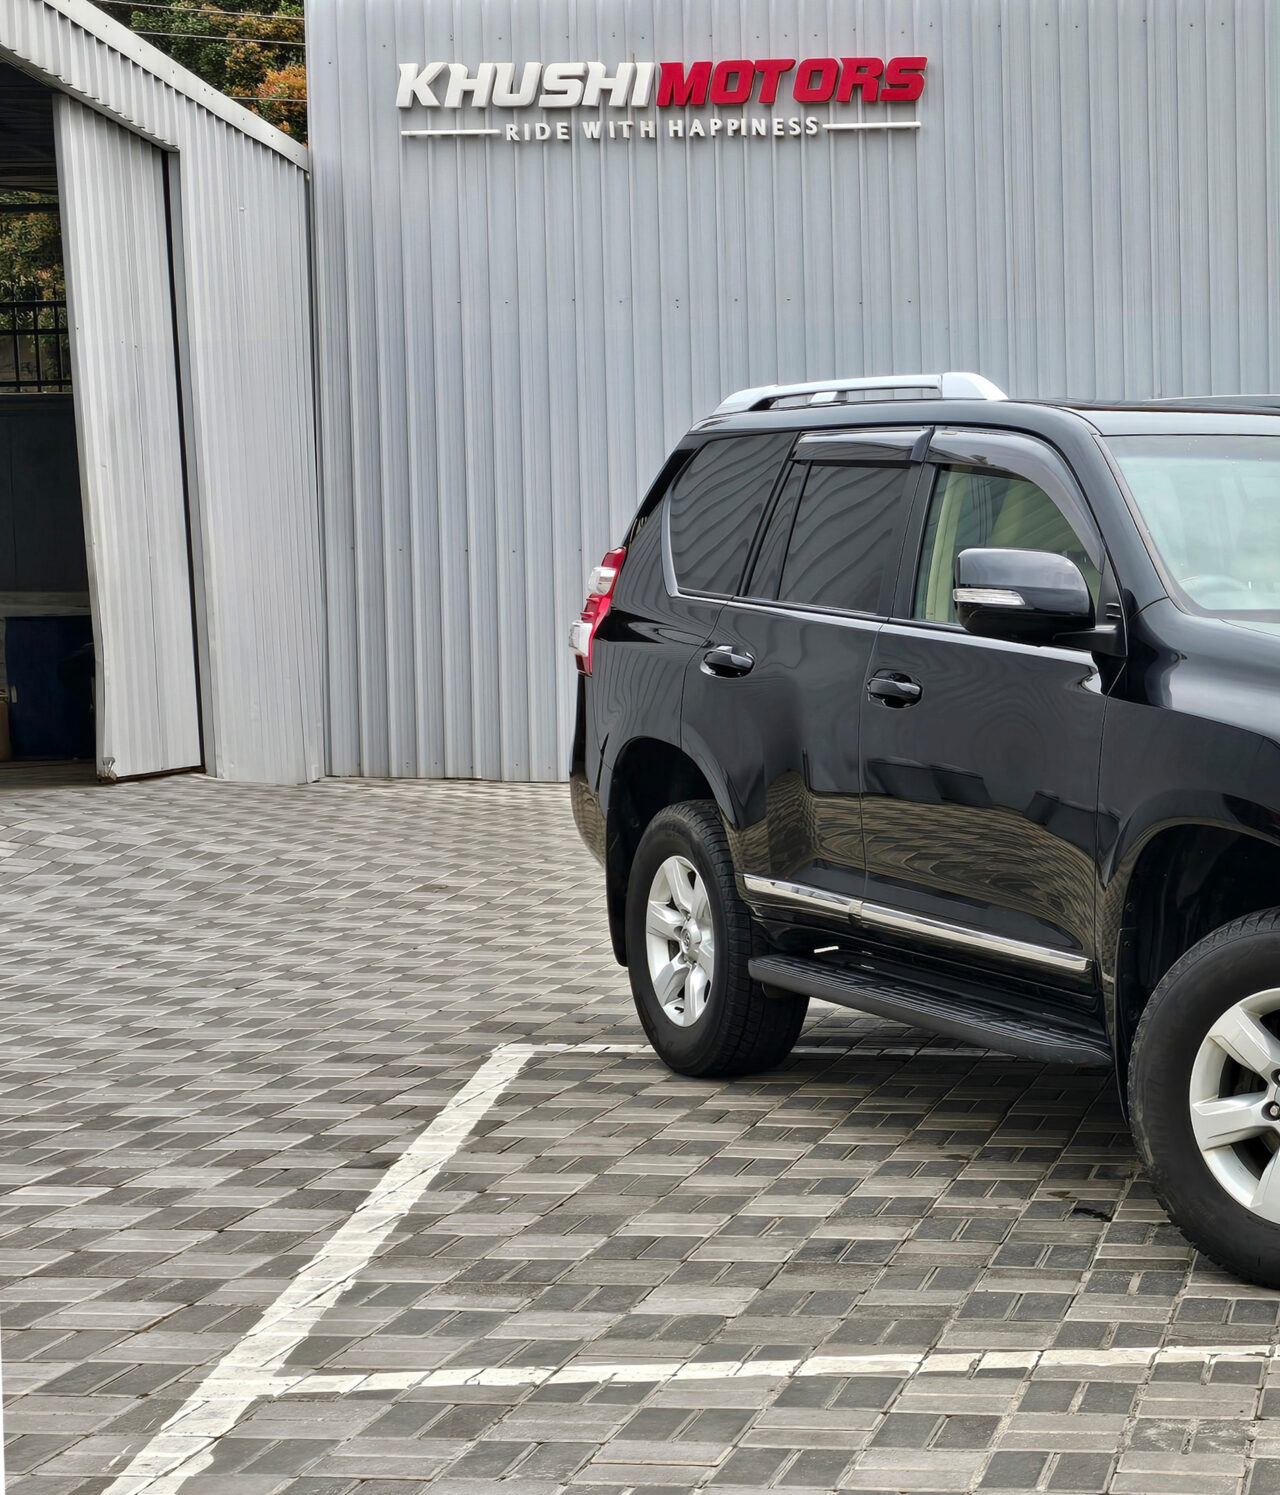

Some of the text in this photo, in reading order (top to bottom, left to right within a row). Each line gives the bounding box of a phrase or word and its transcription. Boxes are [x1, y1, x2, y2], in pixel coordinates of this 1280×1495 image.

[505, 115, 819, 142] RIDE WITH HAPPINESS
